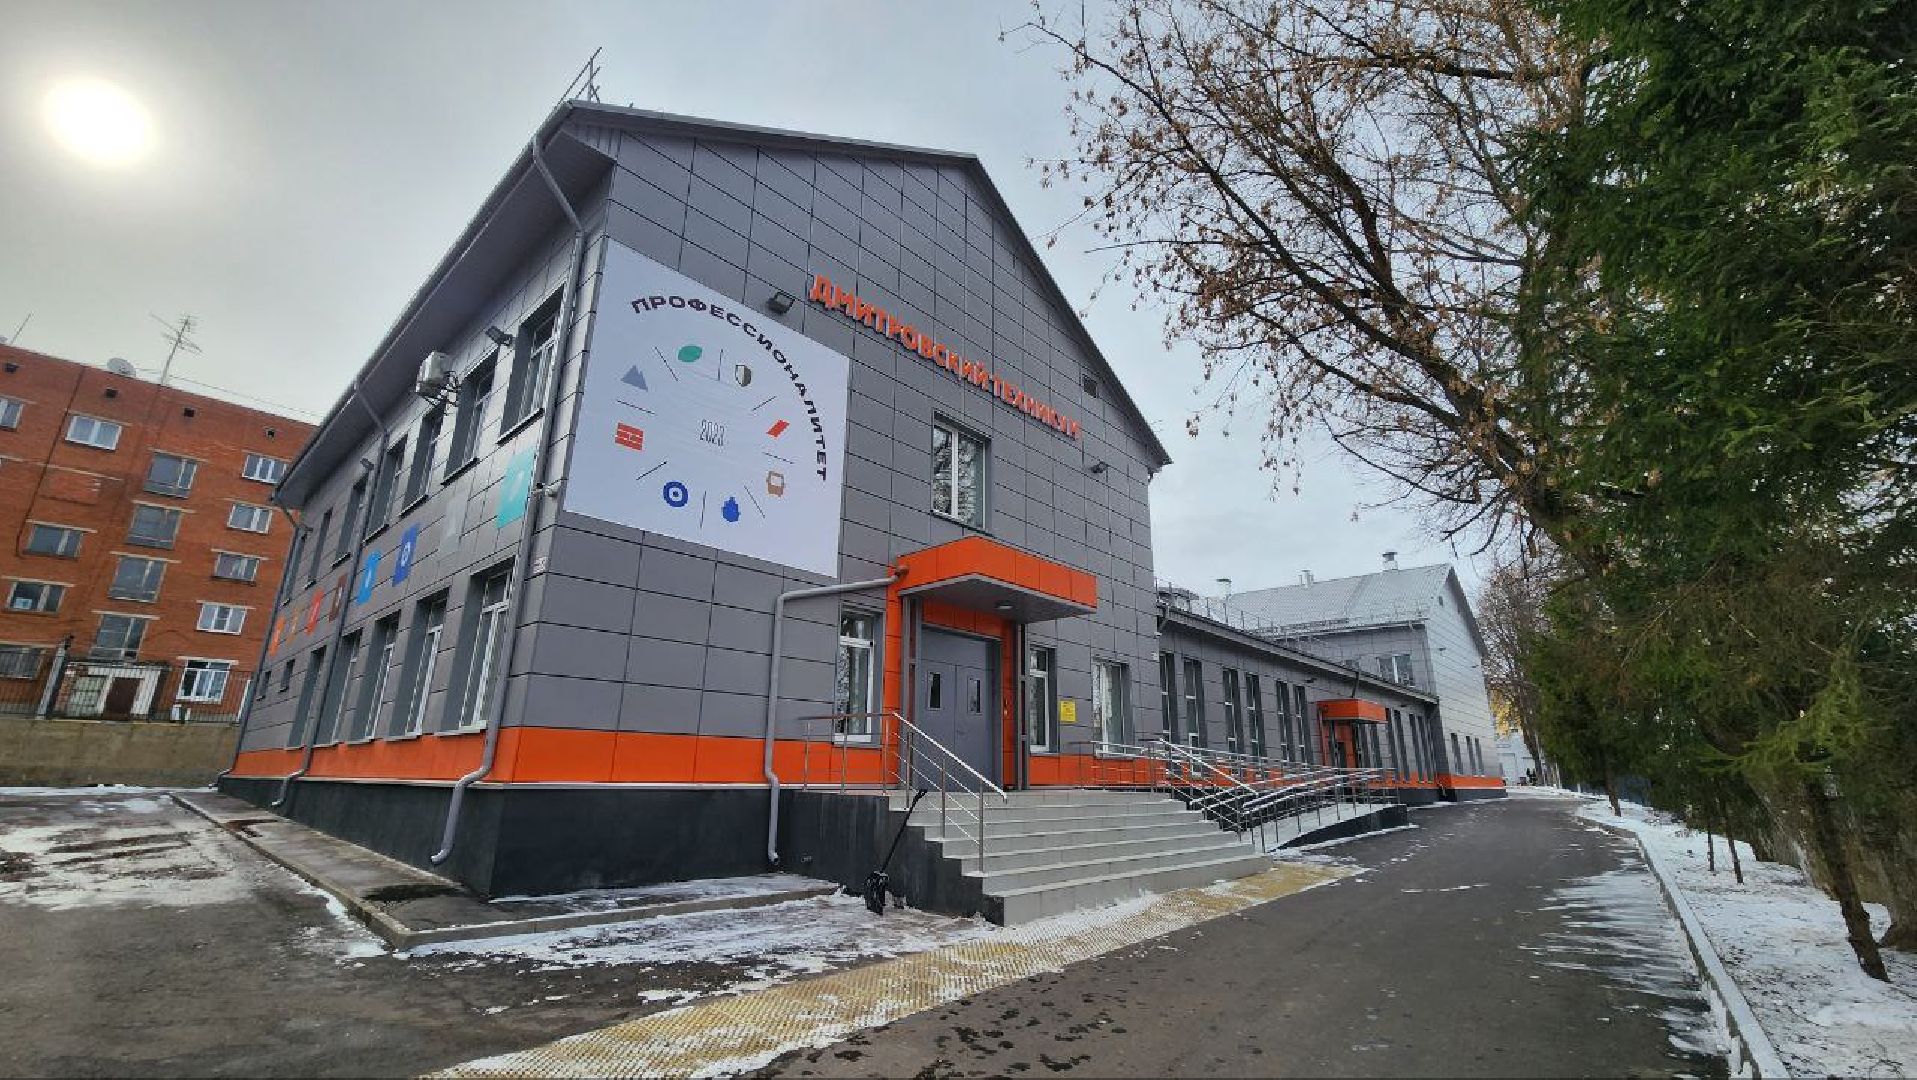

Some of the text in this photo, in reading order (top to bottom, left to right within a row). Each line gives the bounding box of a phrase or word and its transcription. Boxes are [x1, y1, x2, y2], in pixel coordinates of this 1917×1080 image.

[631, 295, 827, 481] ПРОФЕССИОНАЛИТЕТ
[809, 274, 1081, 440] ДМИТРОВСКИЙ ТЕХНИКУМ
